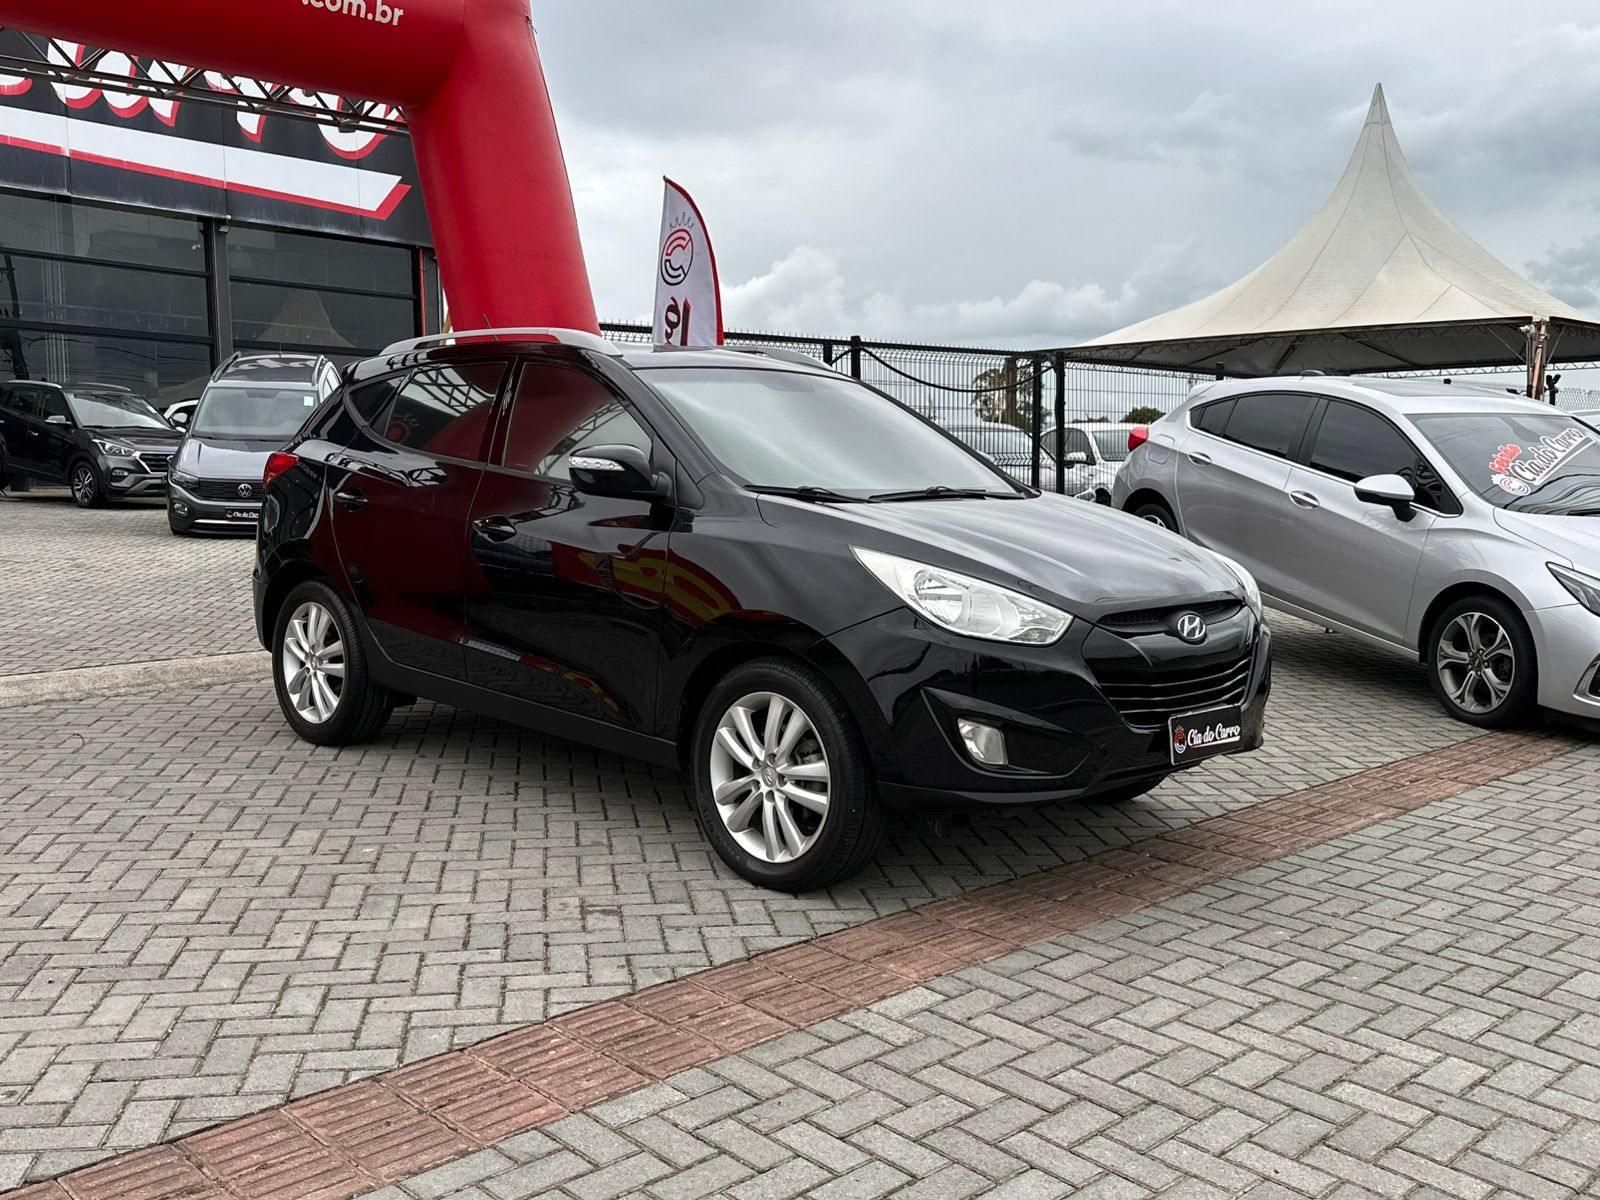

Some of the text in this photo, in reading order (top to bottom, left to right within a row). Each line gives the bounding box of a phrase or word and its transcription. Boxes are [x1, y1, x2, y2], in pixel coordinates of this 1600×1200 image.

[1187, 722, 1241, 746] Cia do Carro
